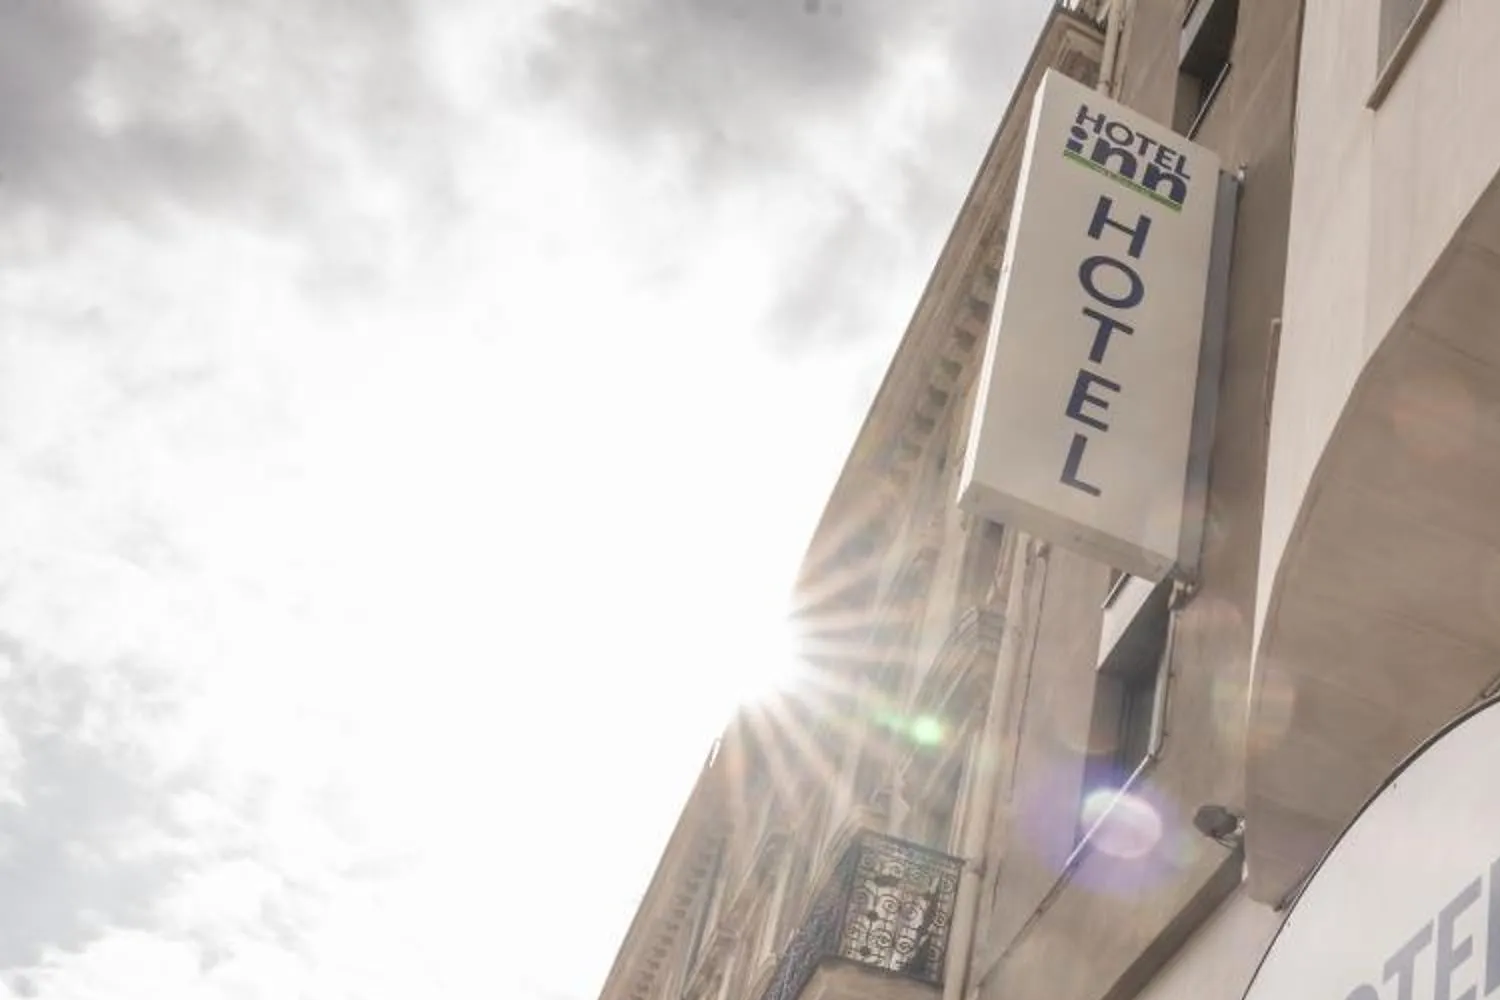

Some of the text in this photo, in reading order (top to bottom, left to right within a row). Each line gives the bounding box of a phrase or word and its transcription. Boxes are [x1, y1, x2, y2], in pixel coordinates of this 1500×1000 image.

[1065, 125, 1187, 205] inn
[1075, 104, 1191, 180] HOTEL
[1060, 195, 1152, 498] HOTEL
